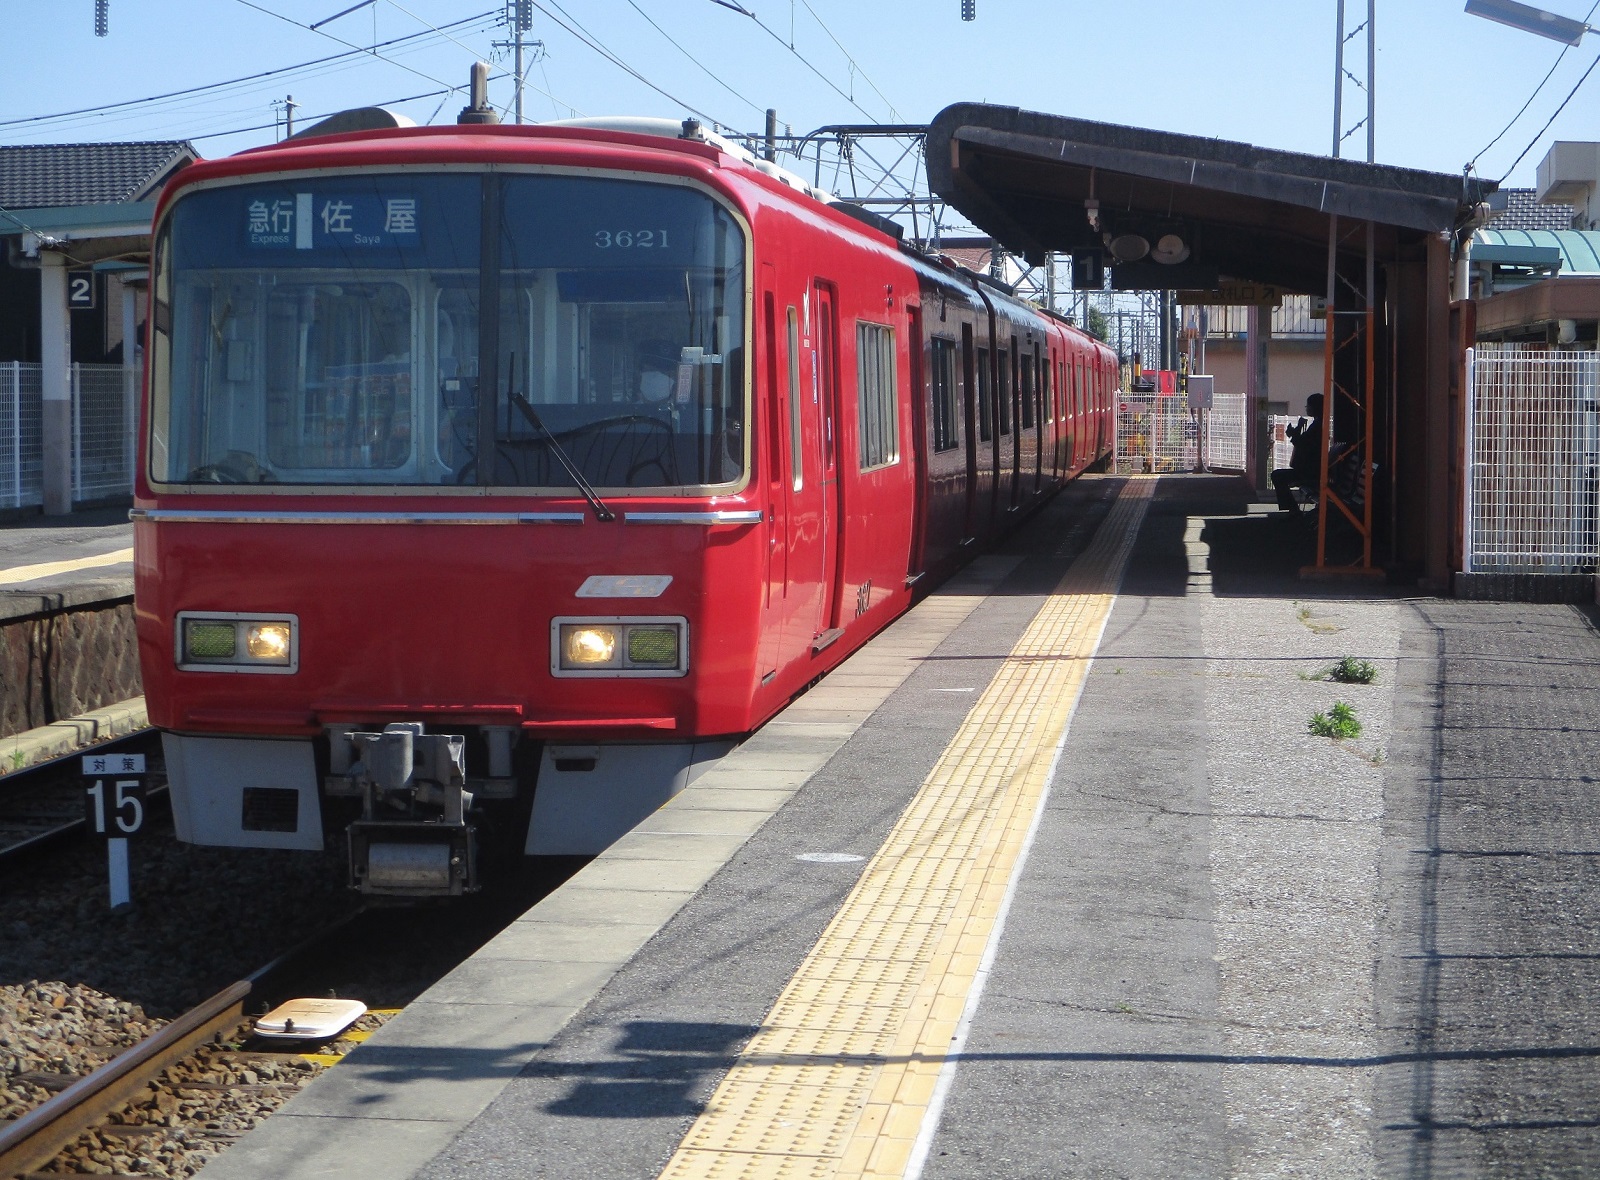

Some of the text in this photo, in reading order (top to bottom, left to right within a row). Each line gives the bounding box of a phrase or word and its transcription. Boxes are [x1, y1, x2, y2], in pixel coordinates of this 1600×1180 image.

[249, 200, 293, 233] 急行
[251, 234, 289, 244] Express
[354, 233, 381, 245] Saya
[595, 229, 669, 248] 3621
[1079, 255, 1094, 281] 1
[71, 278, 90, 301] 2
[93, 758, 135, 772] 対策
[87, 779, 143, 833] 15
